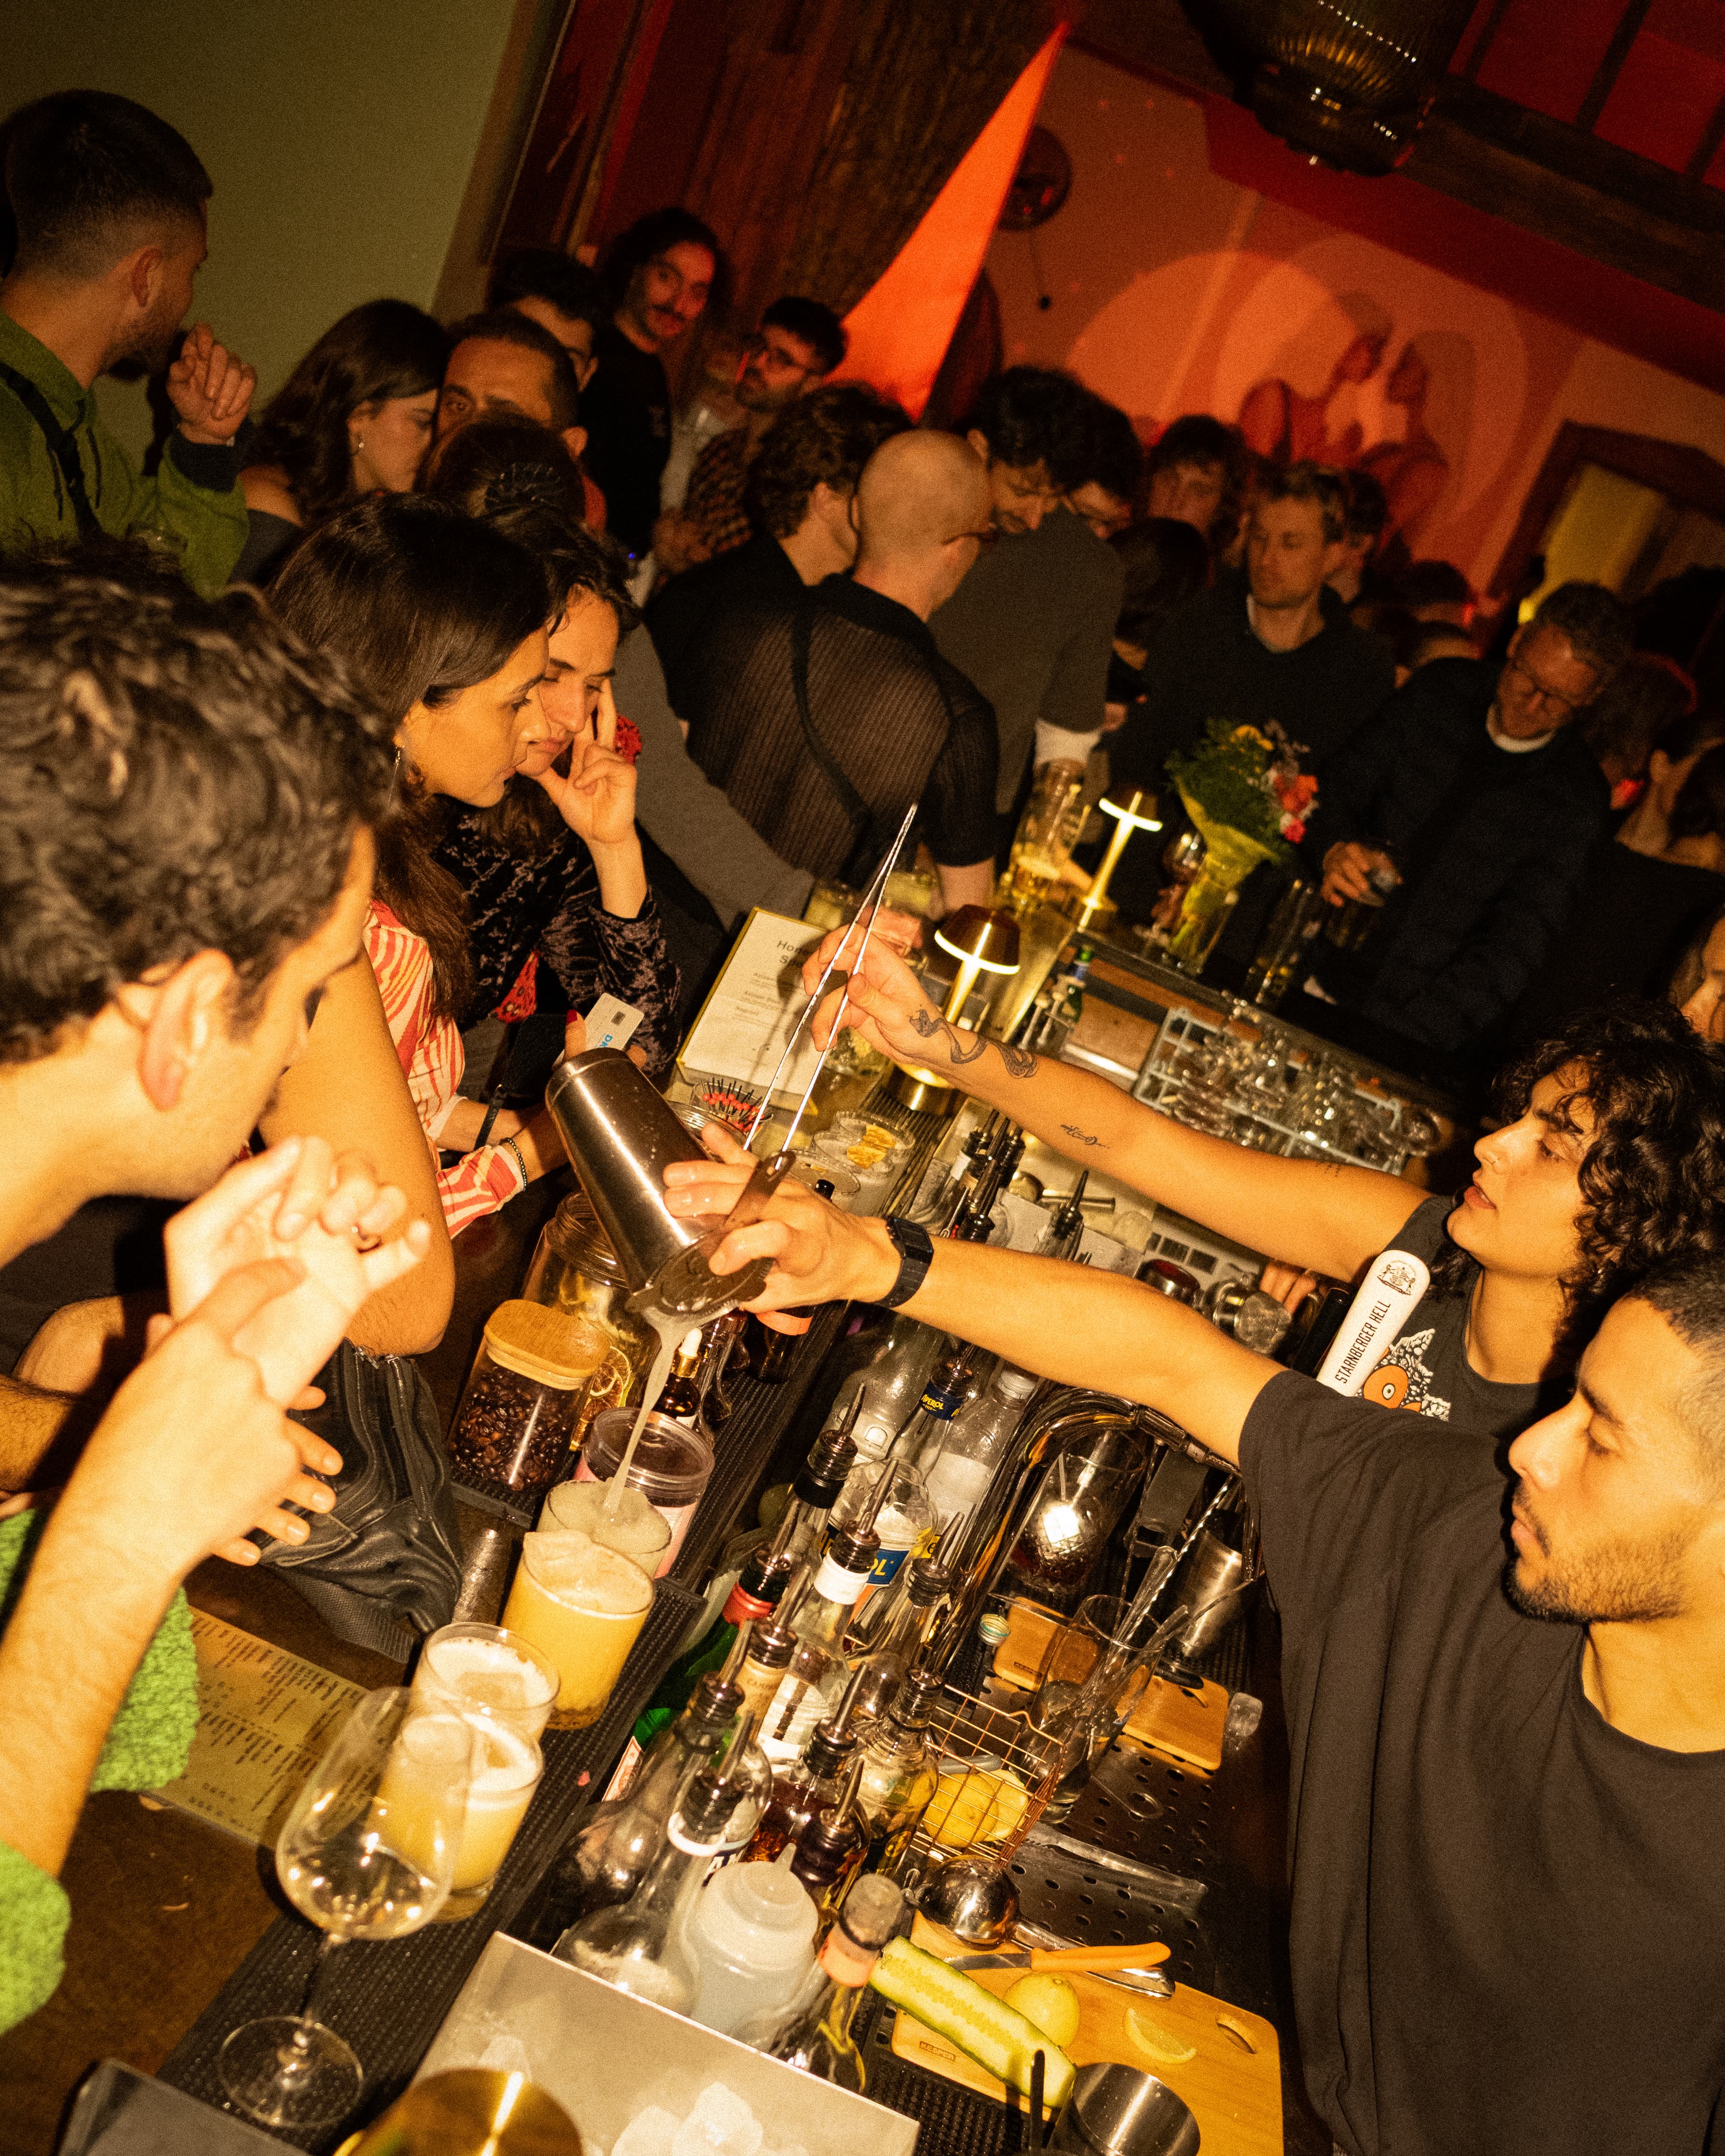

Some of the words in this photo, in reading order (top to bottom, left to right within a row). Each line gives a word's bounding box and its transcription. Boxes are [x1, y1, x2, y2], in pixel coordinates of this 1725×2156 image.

[1335, 1322, 1377, 1383] STARNBERGER
[1369, 1301, 1391, 1324] HELL
[921, 1394, 944, 1410] APEROL
[920, 2042, 955, 2061] KESPER
